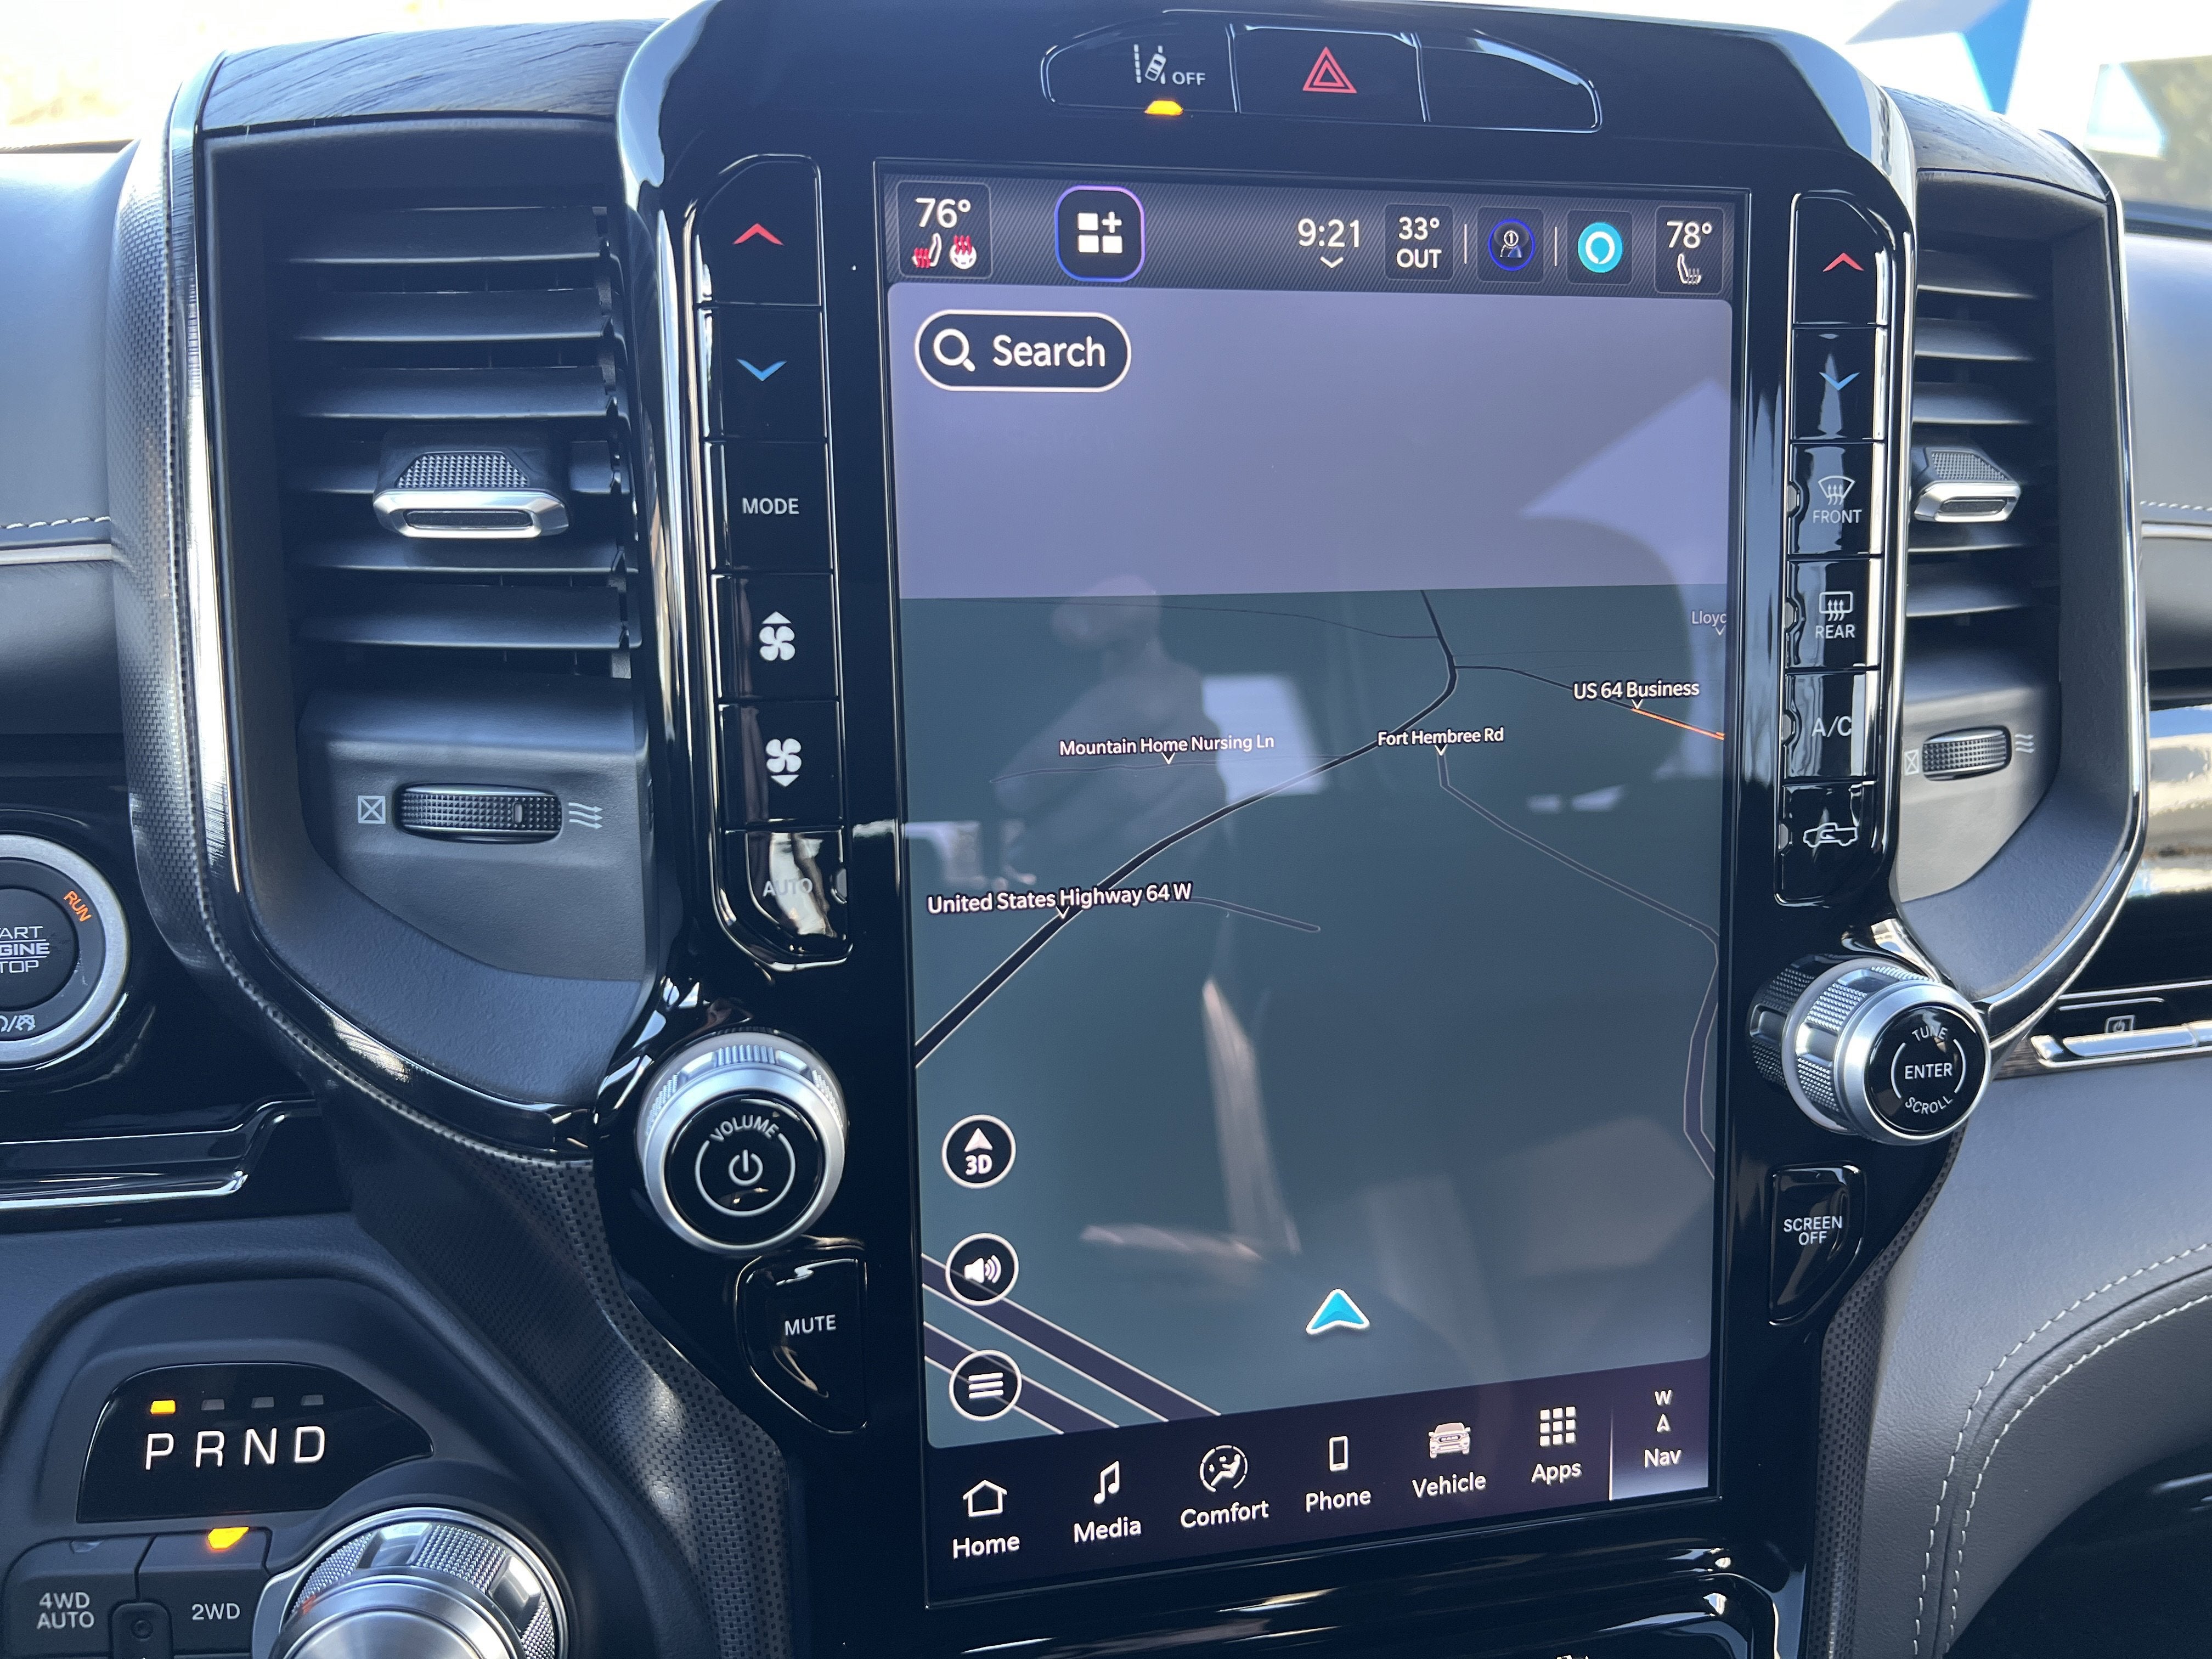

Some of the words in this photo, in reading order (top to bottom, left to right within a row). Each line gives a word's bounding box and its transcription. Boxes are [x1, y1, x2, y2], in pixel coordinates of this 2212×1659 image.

[1172, 71, 1205, 86] OFF
[916, 198, 971, 228] 76°
[1297, 218, 1359, 247] 9:21
[1398, 216, 1440, 240] 33°
[1667, 221, 1712, 249] 78°
[1396, 248, 1442, 268] OUT
[992, 334, 1105, 367] Search
[742, 498, 799, 515] MODE
[1812, 509, 1863, 524] FRONT
[1815, 624, 1855, 639] REAR
[1574, 682, 1598, 699] US
[1601, 682, 1623, 698] 64
[1627, 680, 1700, 698] Business
[1812, 715, 1853, 737] A/C
[1060, 738, 1136, 755] Mountain
[1141, 738, 1188, 753] Home
[1192, 735, 1253, 753] Nursing
[1257, 734, 1274, 748] Ln
[1378, 731, 1409, 746] Fort
[1412, 729, 1481, 747] Hembree
[1484, 727, 1504, 742] Rd
[763, 878, 812, 897] AUTO
[64, 890, 92, 922] RUN
[928, 894, 992, 913] United
[997, 892, 1056, 910] States
[1060, 887, 1143, 909] Highway
[1146, 885, 1170, 901] 64
[1173, 883, 1192, 900] W
[0, 926, 43, 939] ART
[1911, 1025, 1948, 1041] TUNE
[1905, 1062, 1953, 1079] ENTER
[1905, 1096, 1953, 1115] SCROLL
[710, 1115, 779, 1141] VOLUME
[965, 1154, 992, 1175] 3D
[1783, 1216, 1843, 1232] SCREEN
[1798, 1231, 1827, 1245] OFF
[785, 1314, 836, 1336] MUTE
[1654, 1389, 1672, 1406] W
[145, 1432, 174, 1470] P
[195, 1430, 224, 1468] R
[244, 1427, 277, 1466] N
[294, 1426, 325, 1463] D
[953, 1536, 1020, 1559] Home
[1074, 1516, 1142, 1543] Media
[1180, 1500, 1269, 1528] Comfort
[1306, 1491, 1371, 1513] Phone
[1412, 1471, 1486, 1498] Vehicle
[1531, 1463, 1582, 1485] Apps
[1644, 1448, 1681, 1469] Nav
[39, 1592, 90, 1609] 4WD
[37, 1611, 94, 1629] AUTO
[191, 1602, 240, 1620] 2WD
